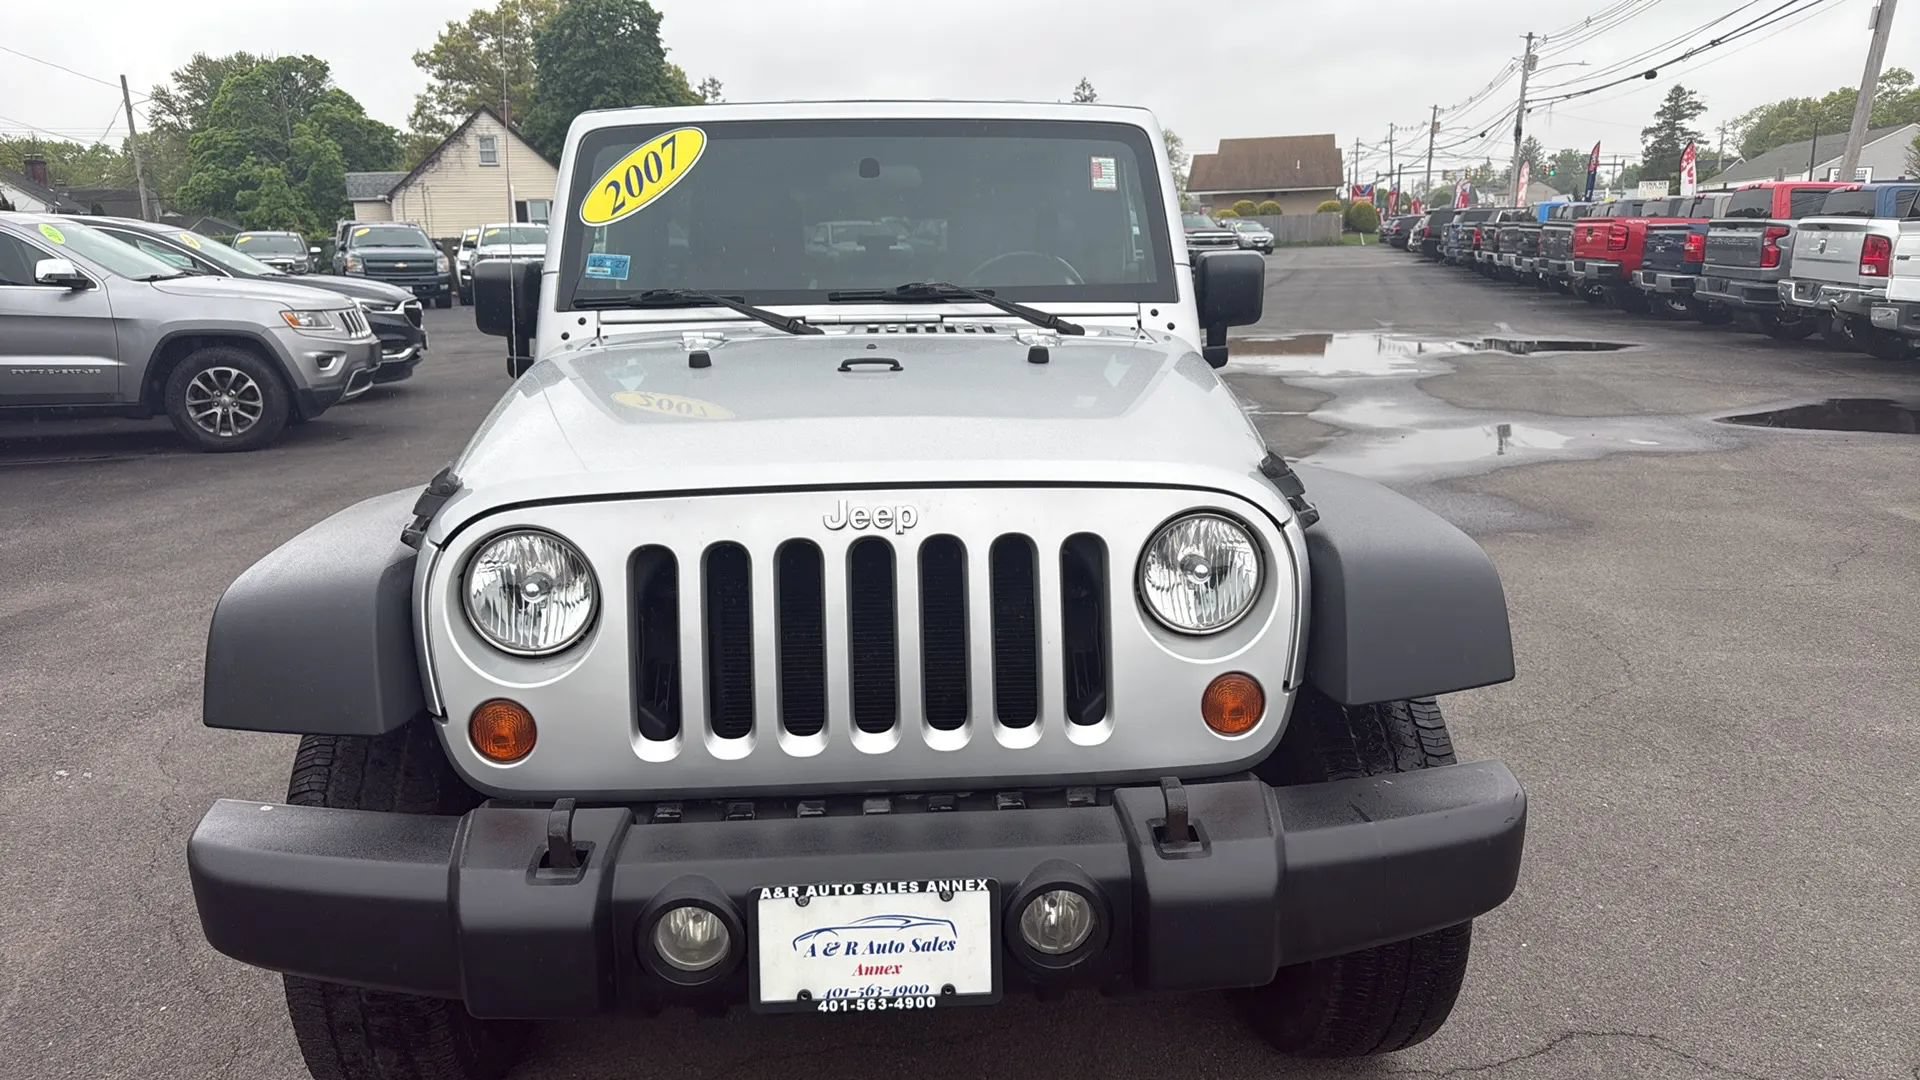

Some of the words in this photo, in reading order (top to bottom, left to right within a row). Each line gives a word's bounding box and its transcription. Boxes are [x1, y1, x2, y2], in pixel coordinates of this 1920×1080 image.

[604, 134, 677, 216] 2007
[823, 499, 918, 535] Jeep
[760, 886, 800, 899] A&R
[806, 883, 855, 896] AUTO
[862, 881, 920, 895] SALES
[926, 879, 989, 892] ANNEX
[803, 942, 817, 958] A
[822, 942, 842, 957] &
[844, 940, 860, 956] R
[862, 939, 905, 955] Auto
[908, 937, 957, 953] Sales
[852, 963, 903, 977] Annex
[818, 997, 936, 1012] 401-563-4900
